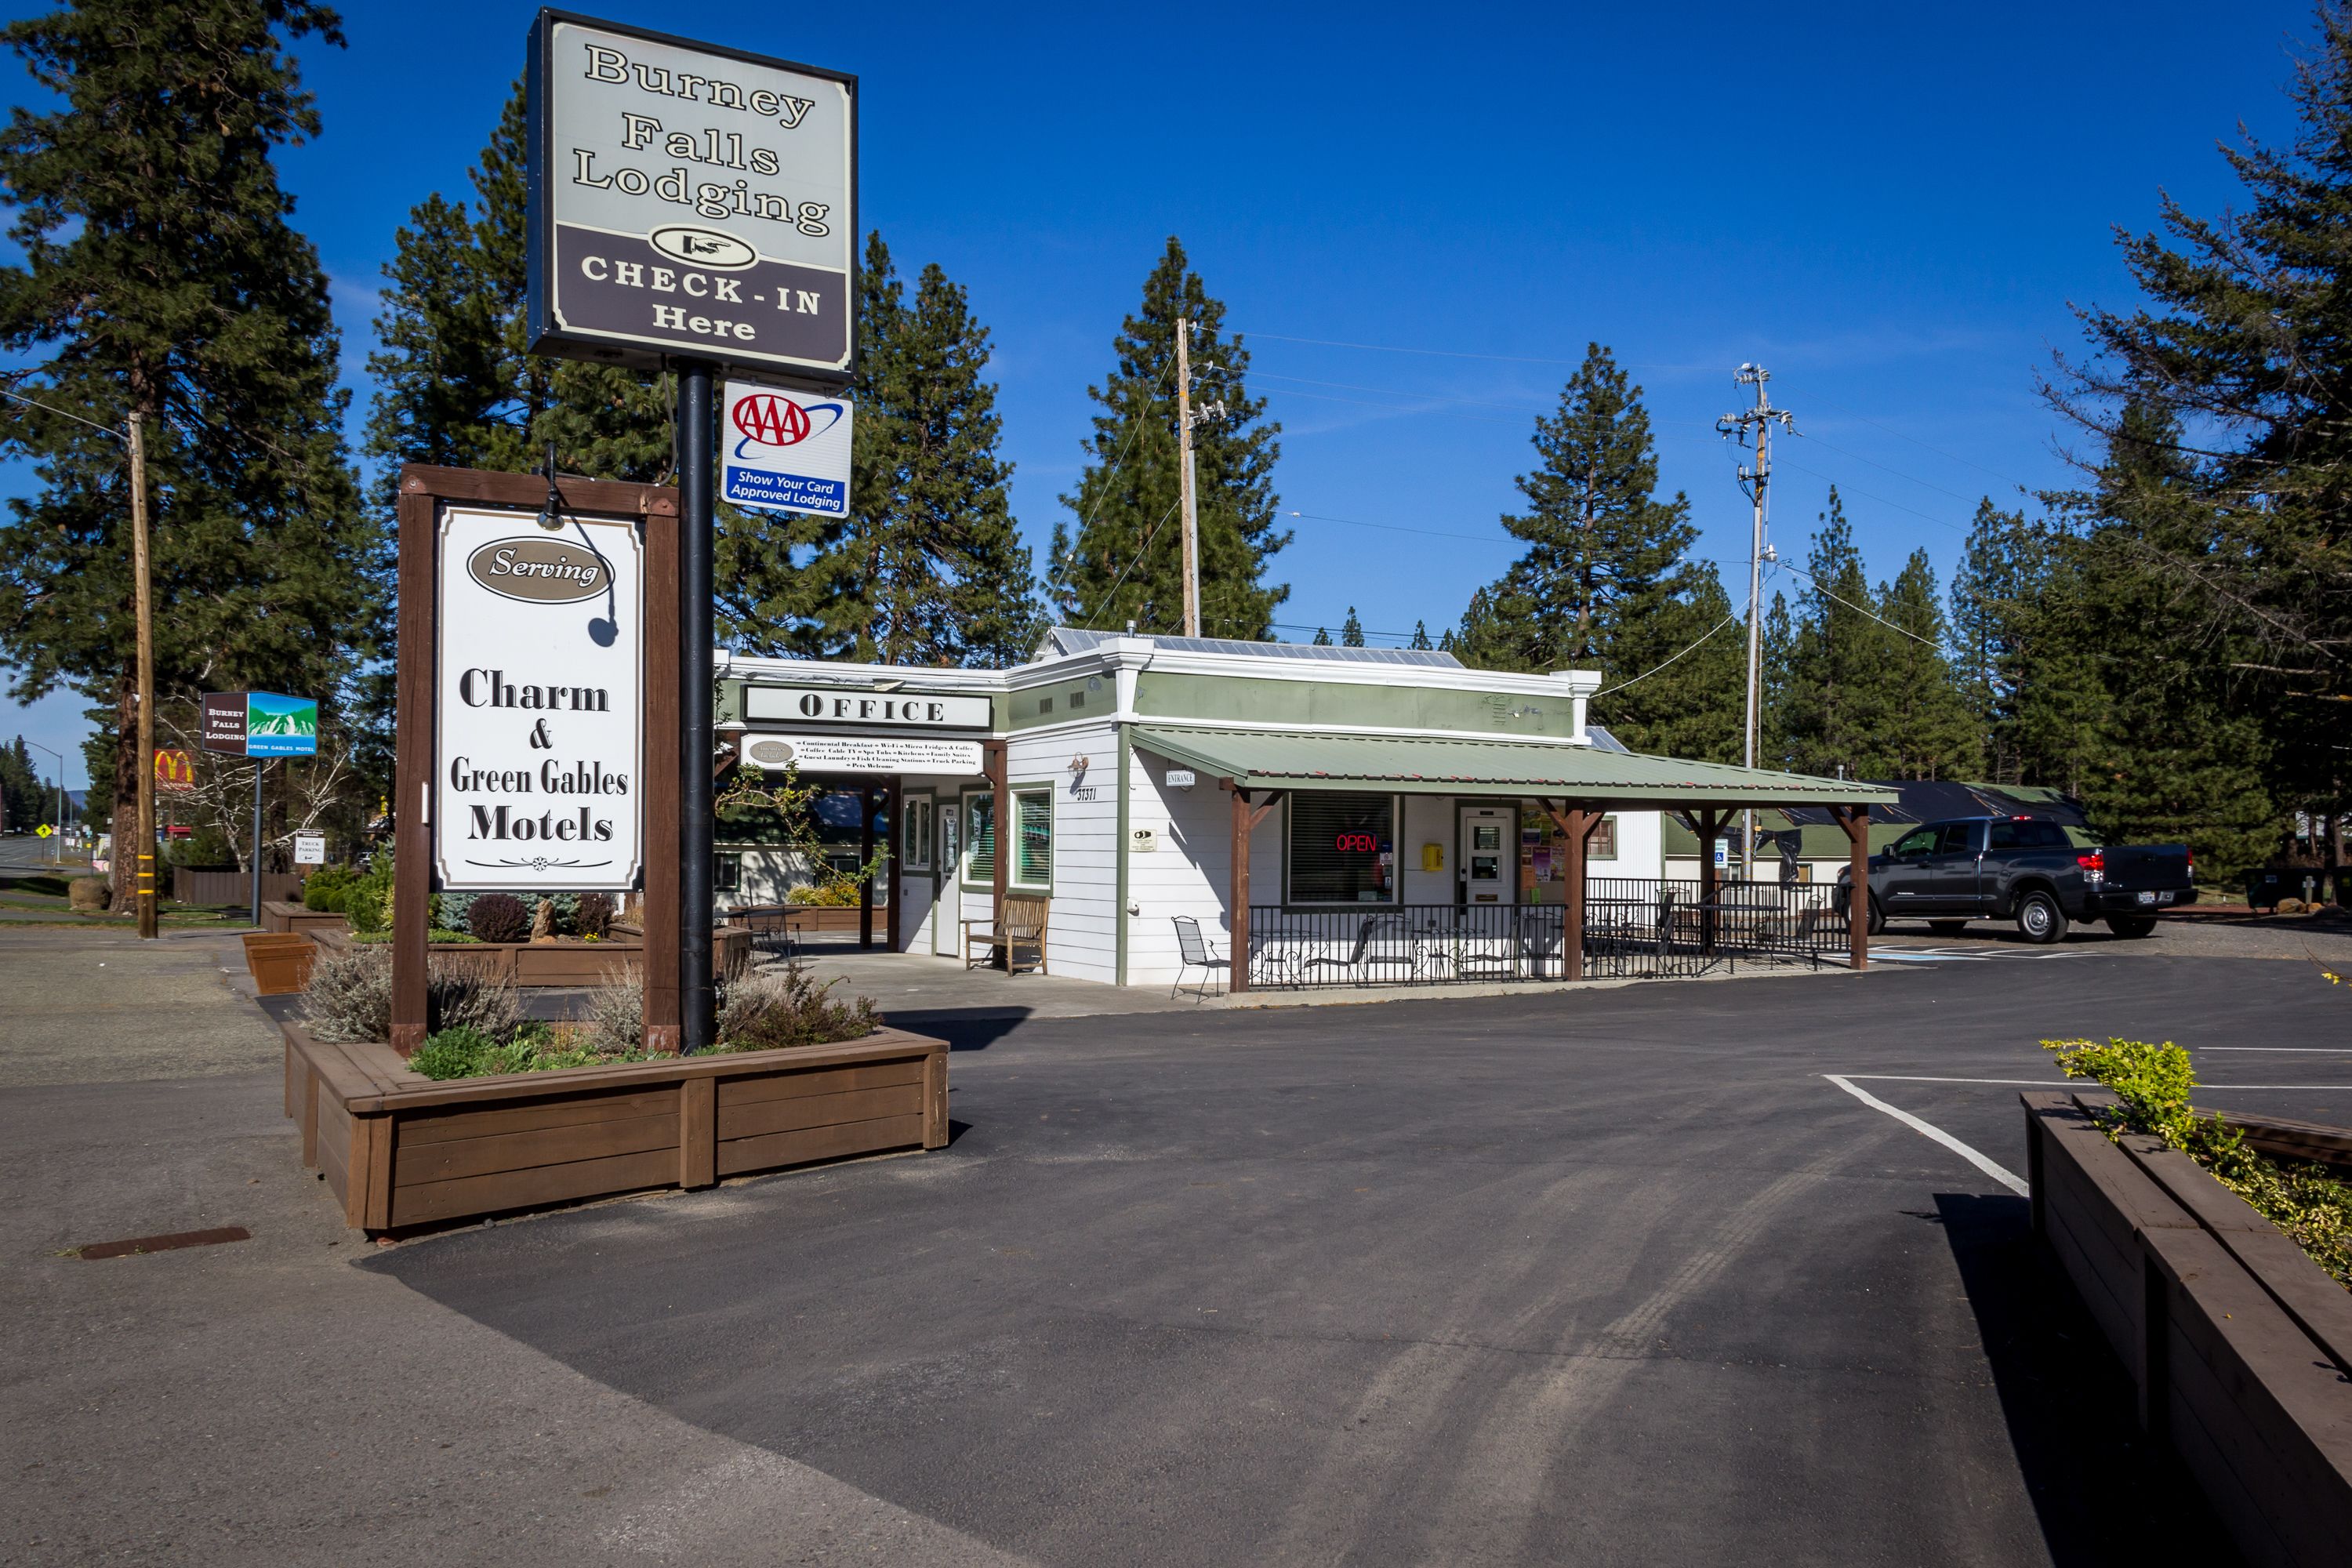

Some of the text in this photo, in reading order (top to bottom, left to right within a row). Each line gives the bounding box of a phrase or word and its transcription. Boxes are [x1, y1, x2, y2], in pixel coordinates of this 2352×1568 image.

[584, 43, 815, 129] Burney
[621, 111, 780, 176] Falls
[573, 148, 830, 238] Lodging
[652, 303, 757, 341] Here
[739, 394, 805, 445] AAA
[731, 484, 840, 510] Approved Lodging
[738, 471, 834, 495] Show Your Card
[488, 548, 601, 587] Serving
[459, 668, 611, 713] Charm
[799, 693, 944, 722] OFFICE
[208, 709, 245, 717] BURNEY
[205, 731, 245, 741] LODGING
[529, 717, 554, 750] &
[450, 756, 629, 797] Green Gables
[1077, 787, 1097, 801] 37371
[1168, 774, 1193, 782] ENTRANCE
[467, 804, 613, 843] Motels
[1337, 834, 1377, 851] OPEN
